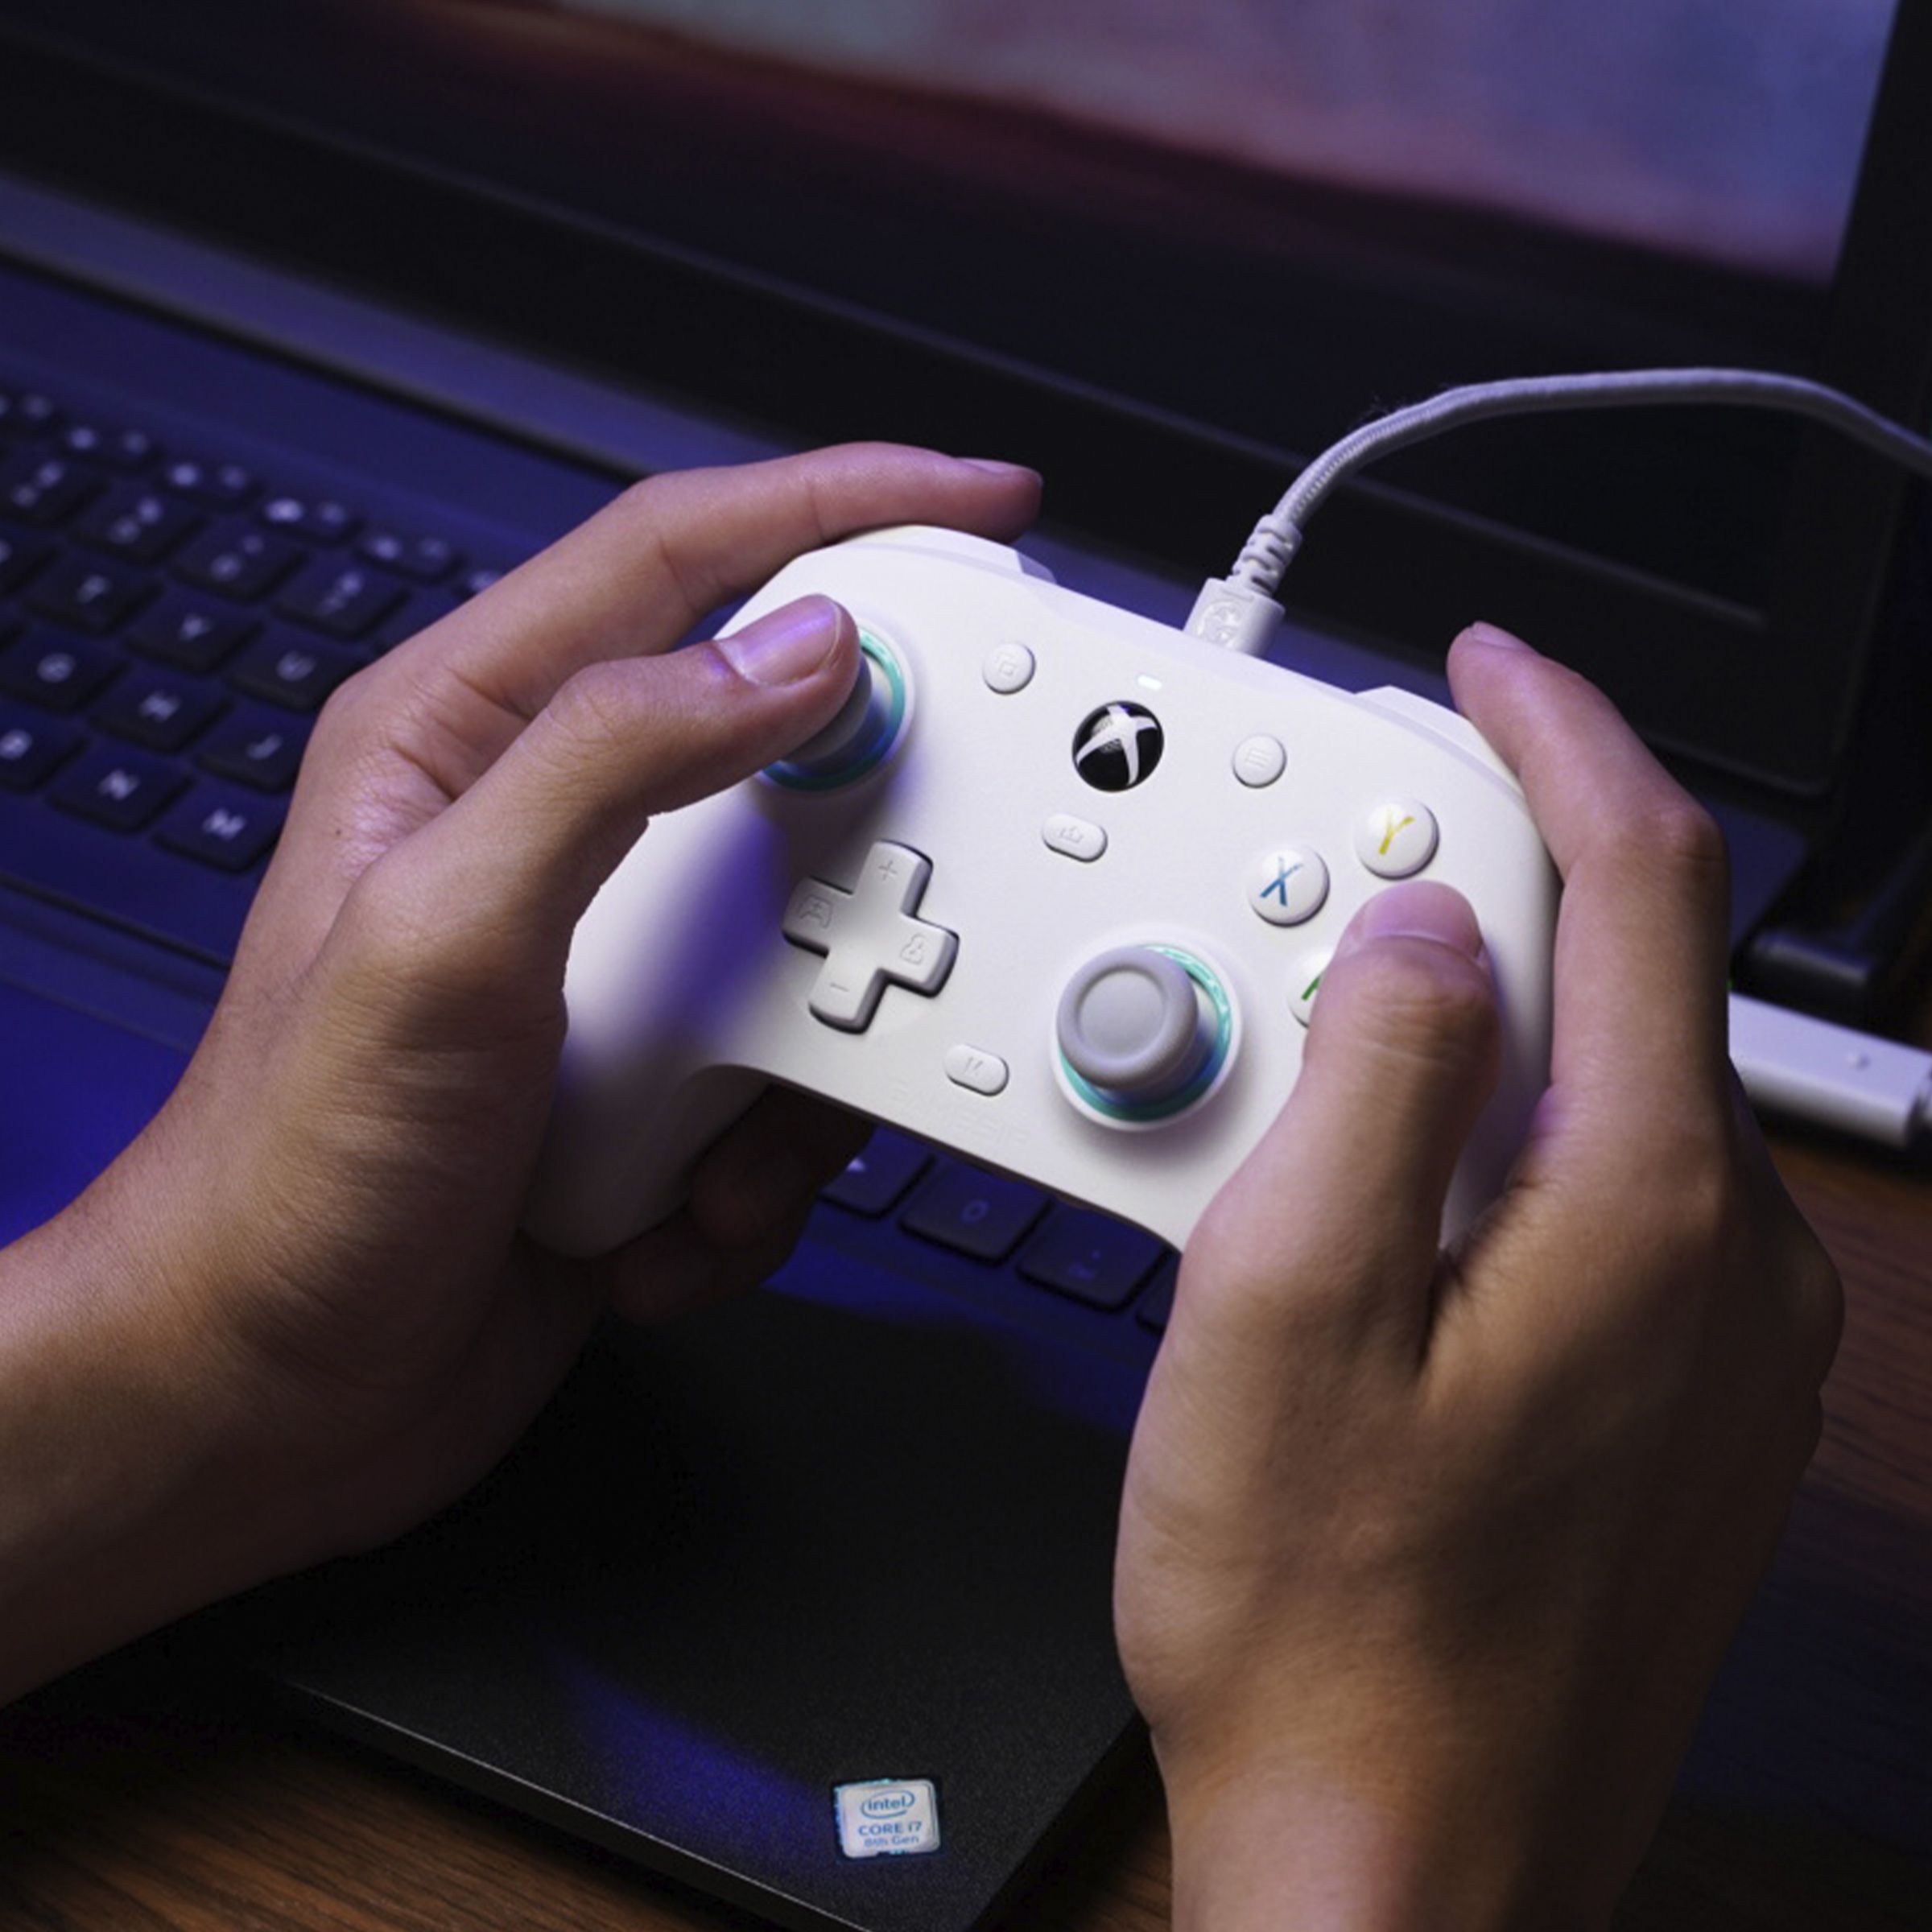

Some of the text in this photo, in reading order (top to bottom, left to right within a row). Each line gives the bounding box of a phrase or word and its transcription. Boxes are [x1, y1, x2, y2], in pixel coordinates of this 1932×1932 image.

[202, 807, 246, 840] M
[1378, 807, 1415, 856] Y
[1260, 855, 1303, 906] X
[868, 1795, 906, 1811] intel
[857, 1823, 904, 1836] CORE
[891, 1835, 919, 1845] Gen
